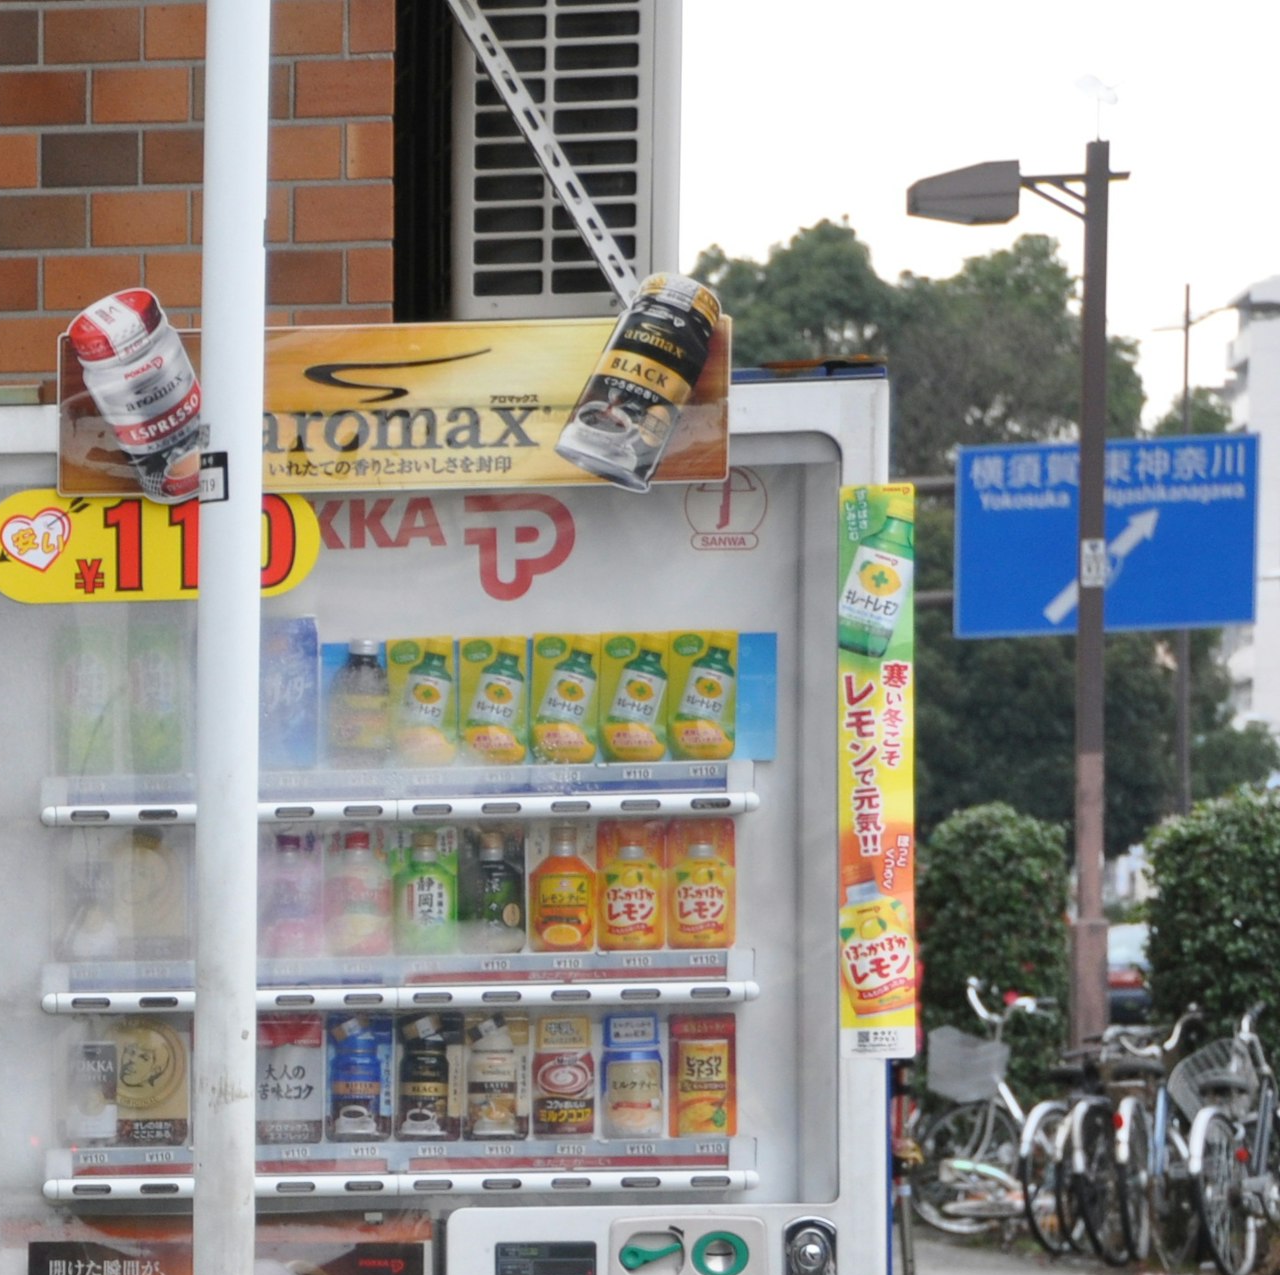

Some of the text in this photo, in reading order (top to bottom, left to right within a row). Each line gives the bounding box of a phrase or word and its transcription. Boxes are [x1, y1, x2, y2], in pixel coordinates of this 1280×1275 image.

[624, 328, 687, 360] aromax
[610, 356, 670, 389] BLACK
[129, 393, 200, 442] ESPRESSO
[268, 456, 513, 478] いれたての香りとおいしさを封印
[1104, 483, 1246, 509] igashikanagawa
[11, 524, 66, 556] 安い
[700, 536, 747, 546] SANWA
[881, 663, 910, 767] 寒い冬こそ
[692, 766, 717, 777] ¥110
[606, 902, 655, 921] レモン
[677, 900, 725, 919] レモン
[556, 959, 581, 969] ¥110
[625, 957, 650, 967] ¥110
[692, 955, 717, 965] ¥110
[849, 954, 911, 986] レモン
[264, 1064, 307, 1080] 大人の
[685, 1067, 722, 1078] コトコト
[256, 1084, 315, 1101] 苦味とコク
[539, 1109, 592, 1123] ミルクココア
